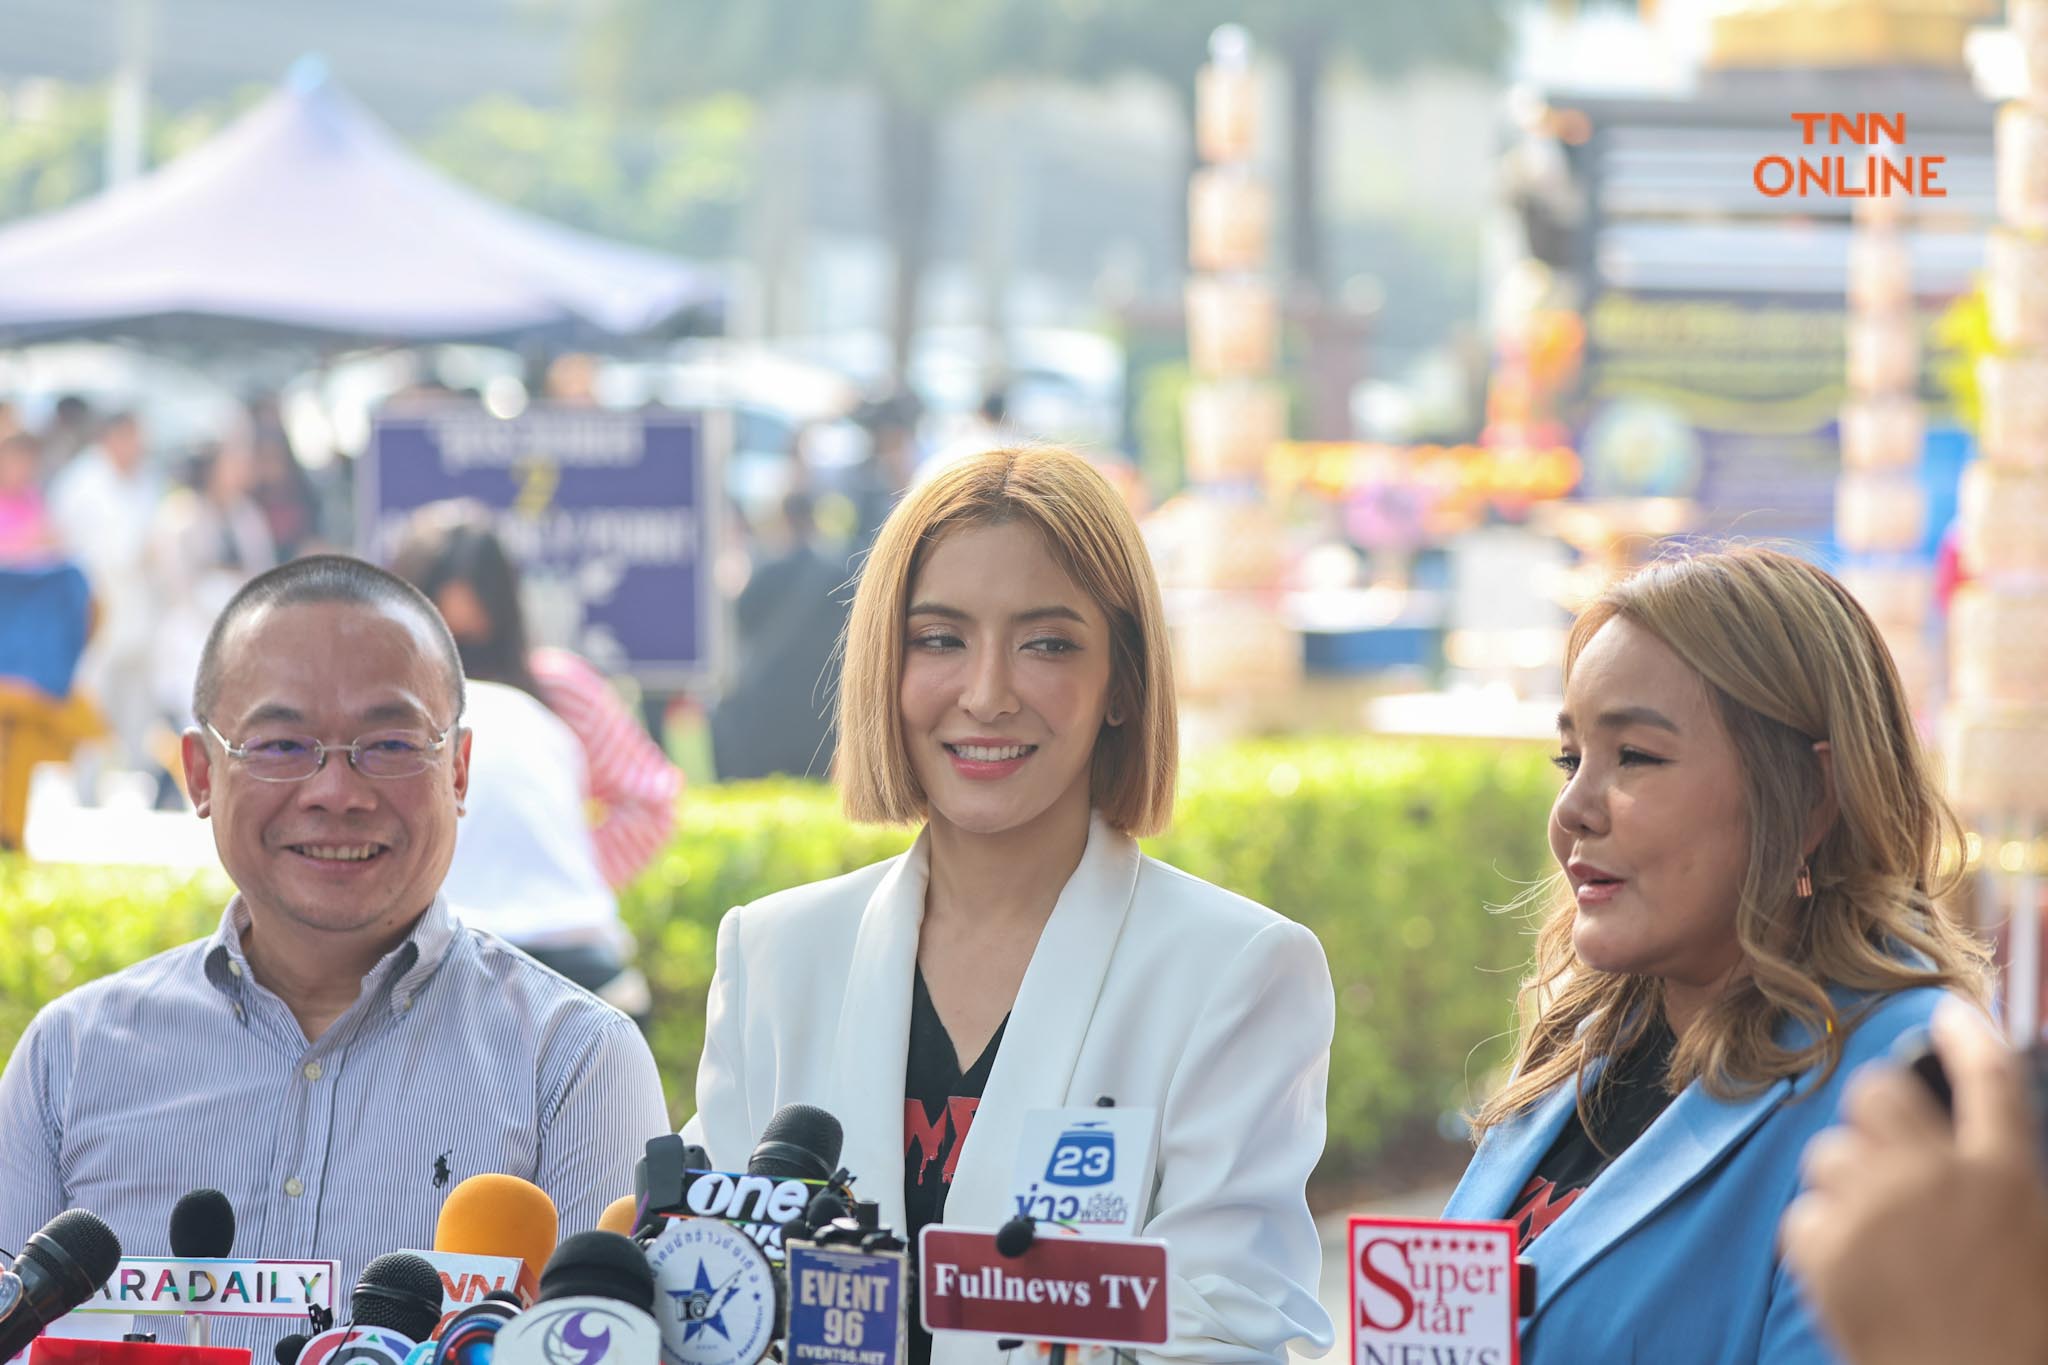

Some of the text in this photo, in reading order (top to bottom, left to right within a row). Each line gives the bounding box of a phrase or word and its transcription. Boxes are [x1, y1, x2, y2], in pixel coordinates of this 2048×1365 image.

[1052, 1145, 1111, 1179] 23
[100, 1268, 322, 1304] RADAILY
[437, 1270, 506, 1304] NN
[799, 1269, 890, 1312] EVENT
[933, 1262, 1159, 1311] Fullnews TV
[823, 1309, 865, 1347] 96
